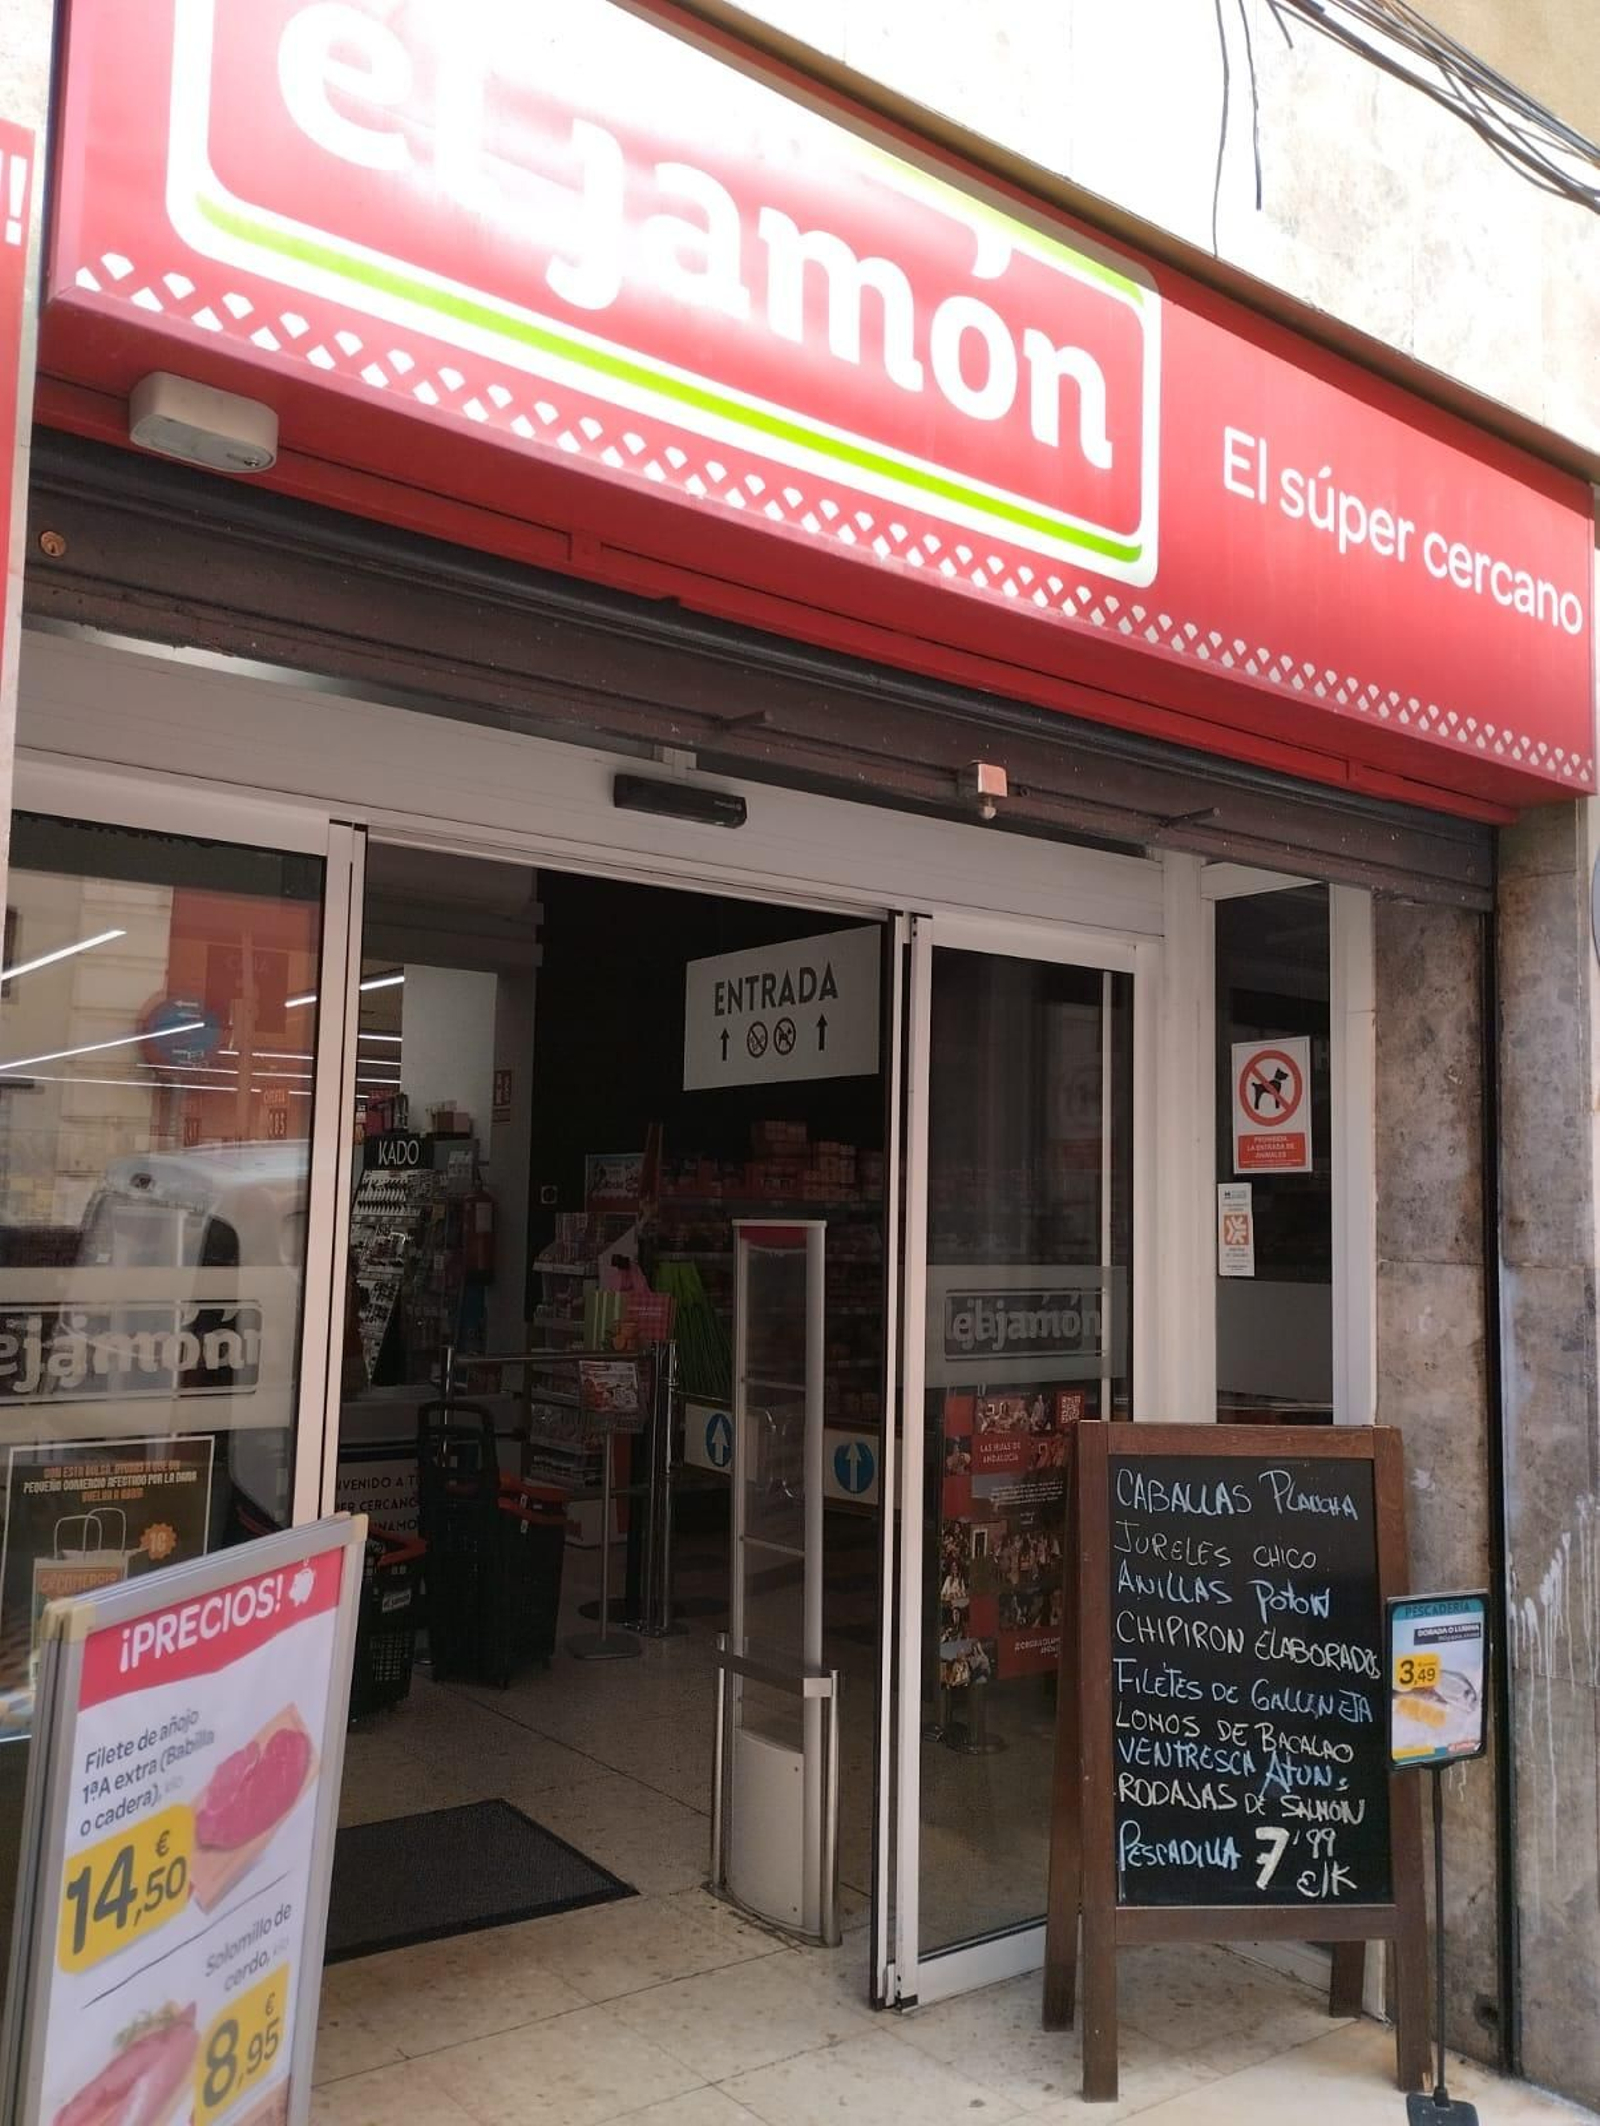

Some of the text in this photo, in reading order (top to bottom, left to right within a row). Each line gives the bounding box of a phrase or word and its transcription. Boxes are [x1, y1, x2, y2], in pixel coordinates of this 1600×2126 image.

[1223, 426, 1584, 635] El súper cercano
[713, 962, 839, 1017] ENTRADA
[378, 1139, 419, 1165] KADO
[1116, 1468, 1252, 1517] CABALLAS
[1114, 1520, 1317, 1569] JURELES CHICO
[1117, 1558, 1233, 1605] ANILLAS
[119, 1573, 284, 1673] ¡PRECIOS!
[1116, 1610, 1381, 1680] CHIPIRON ELABORADOS
[1113, 1657, 1203, 1701] FILETES
[1212, 1682, 1239, 1704] DE
[1399, 1659, 1436, 1686] 3,49
[84, 1707, 200, 1774] Filete de añojo
[1116, 1701, 1355, 1764] LOMOS DE BACALAO
[115, 1761, 158, 1790] extra
[1118, 1738, 1257, 1778] VENTRESCA
[1118, 1772, 1238, 1811] RODAJAS
[1244, 1793, 1265, 1816] DE
[80, 1819, 92, 1837] o
[156, 1829, 171, 1858] €
[1119, 1820, 1243, 1872] PESCADILLA
[67, 1844, 187, 1955] 14,50
[205, 1902, 292, 1977] Solomillo de
[203, 2017, 280, 2108] 8,95
